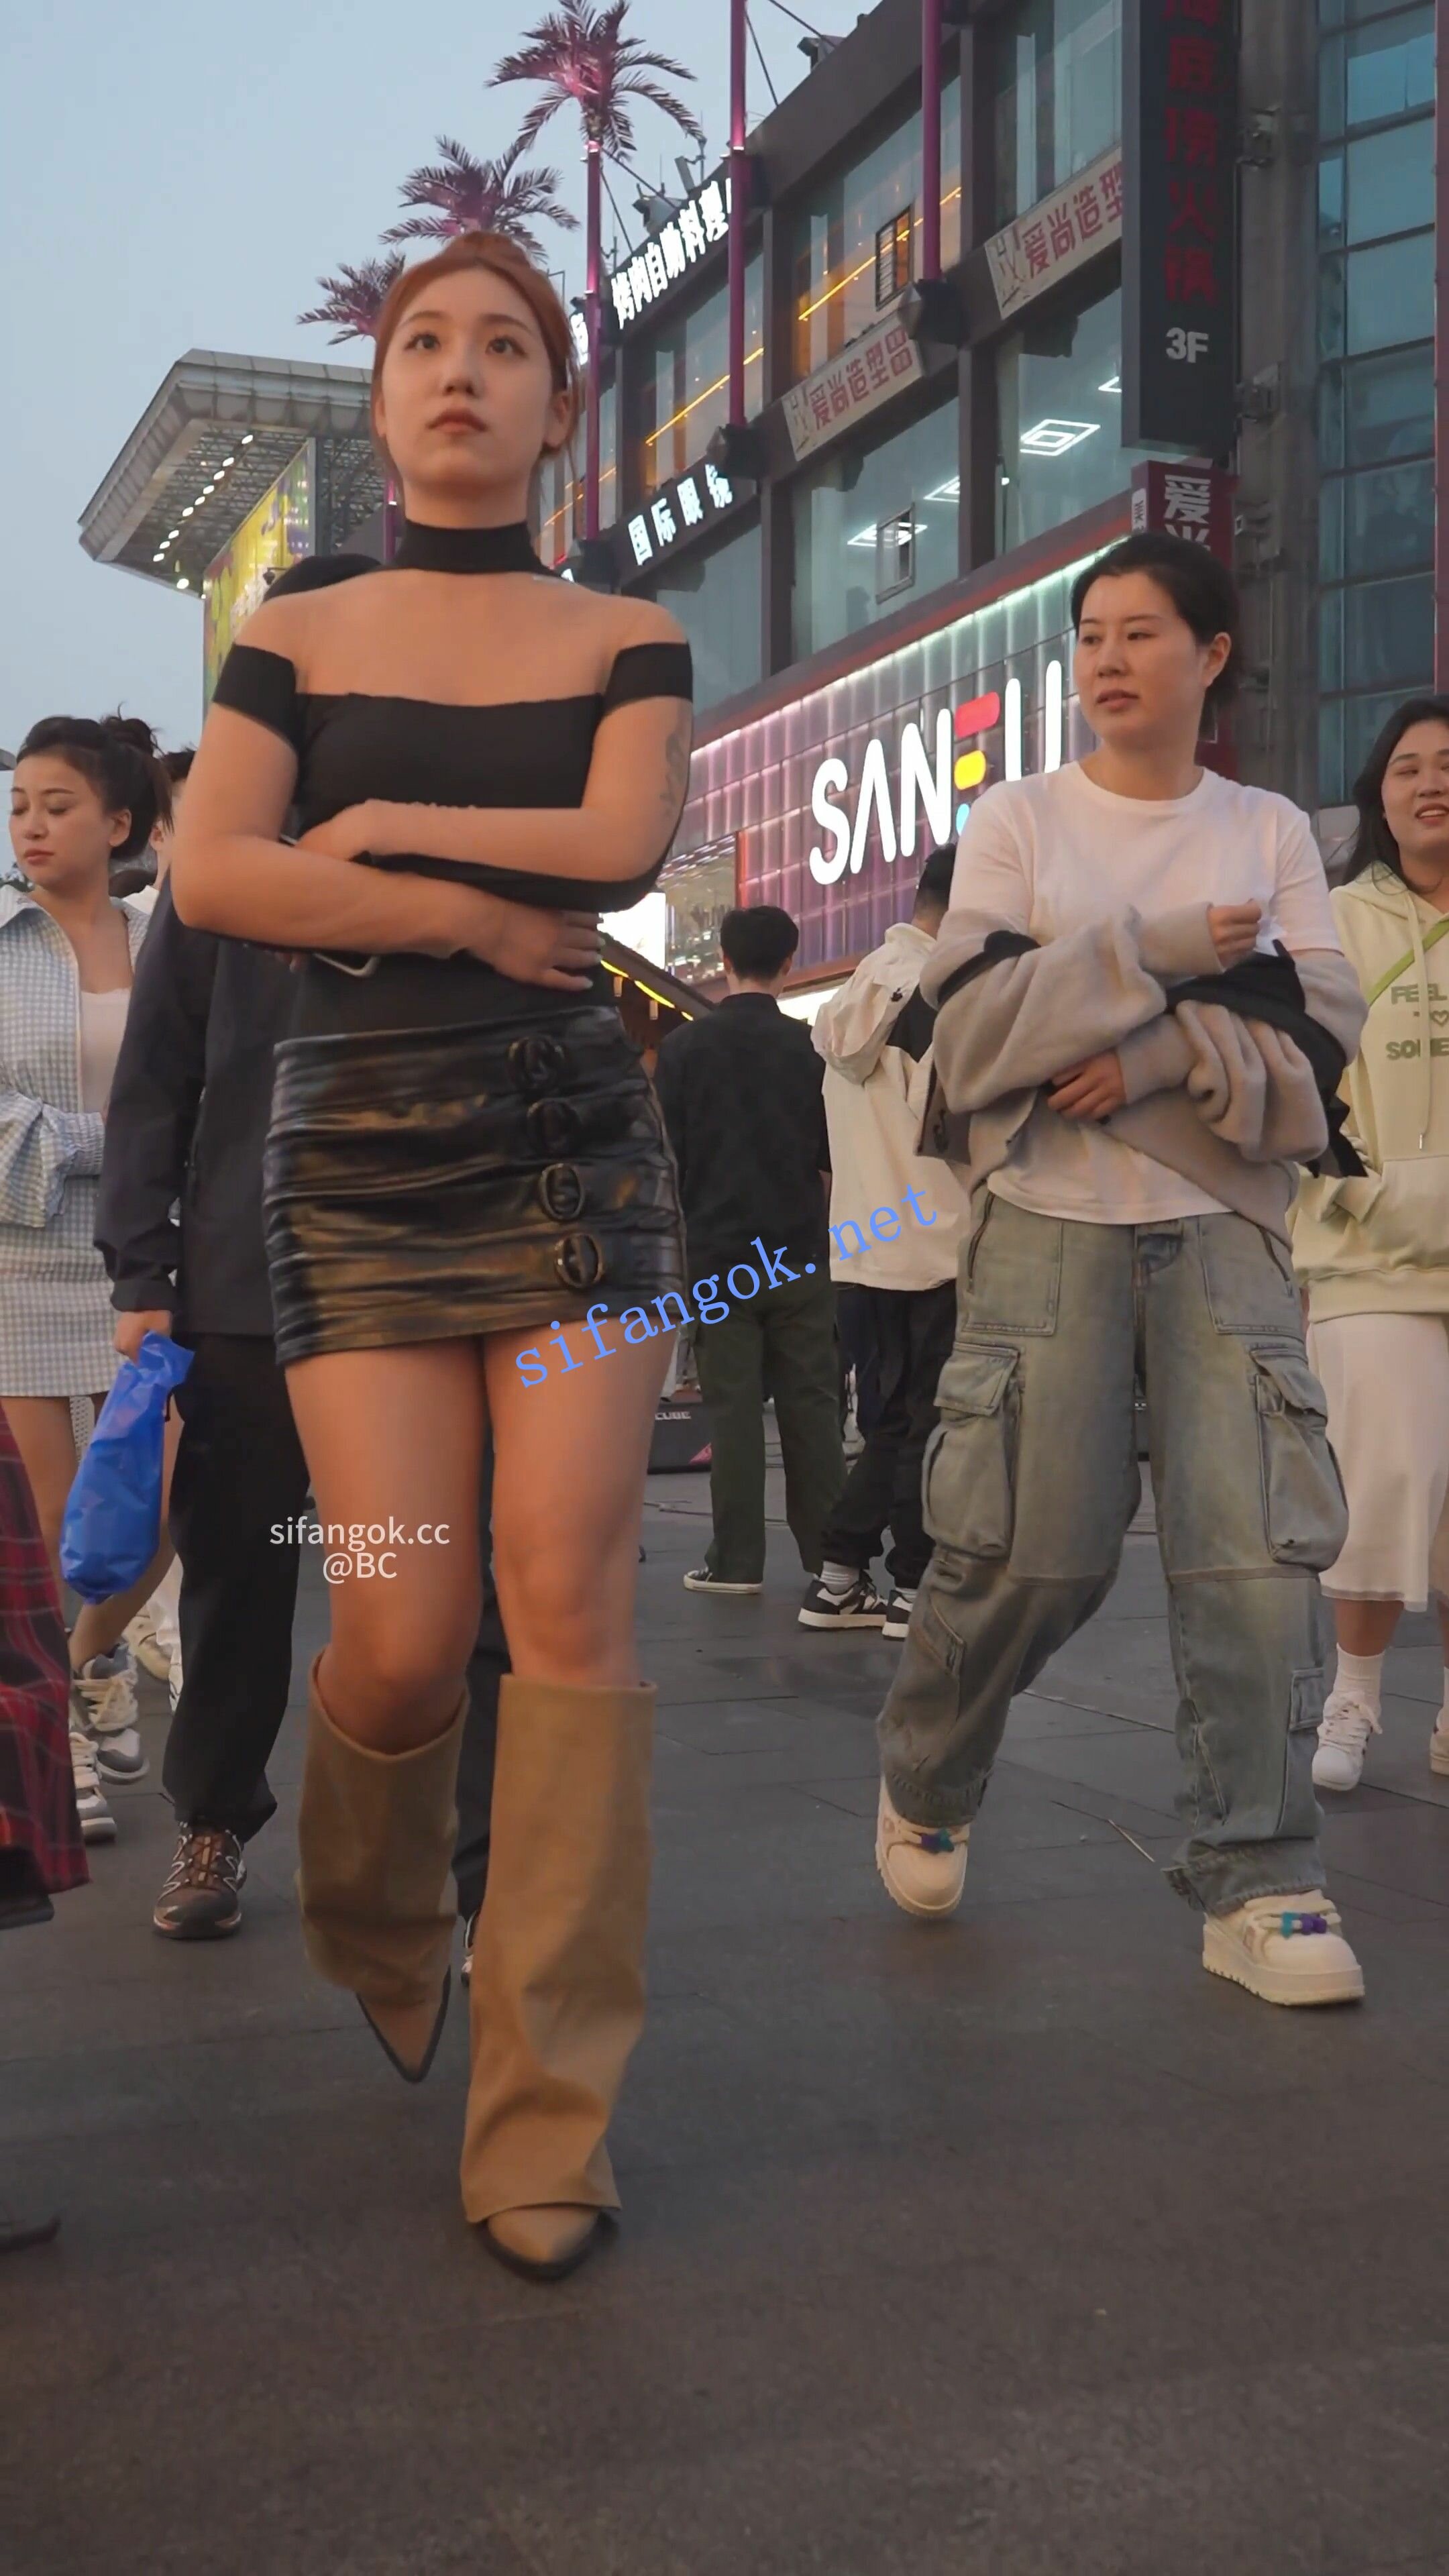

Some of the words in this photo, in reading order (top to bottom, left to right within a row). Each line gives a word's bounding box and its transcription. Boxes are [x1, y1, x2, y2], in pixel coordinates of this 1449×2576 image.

[611, 177, 731, 329] 烤肉自助料理
[1166, 327, 1209, 363] 3F
[628, 464, 733, 566] 国际眼镜
